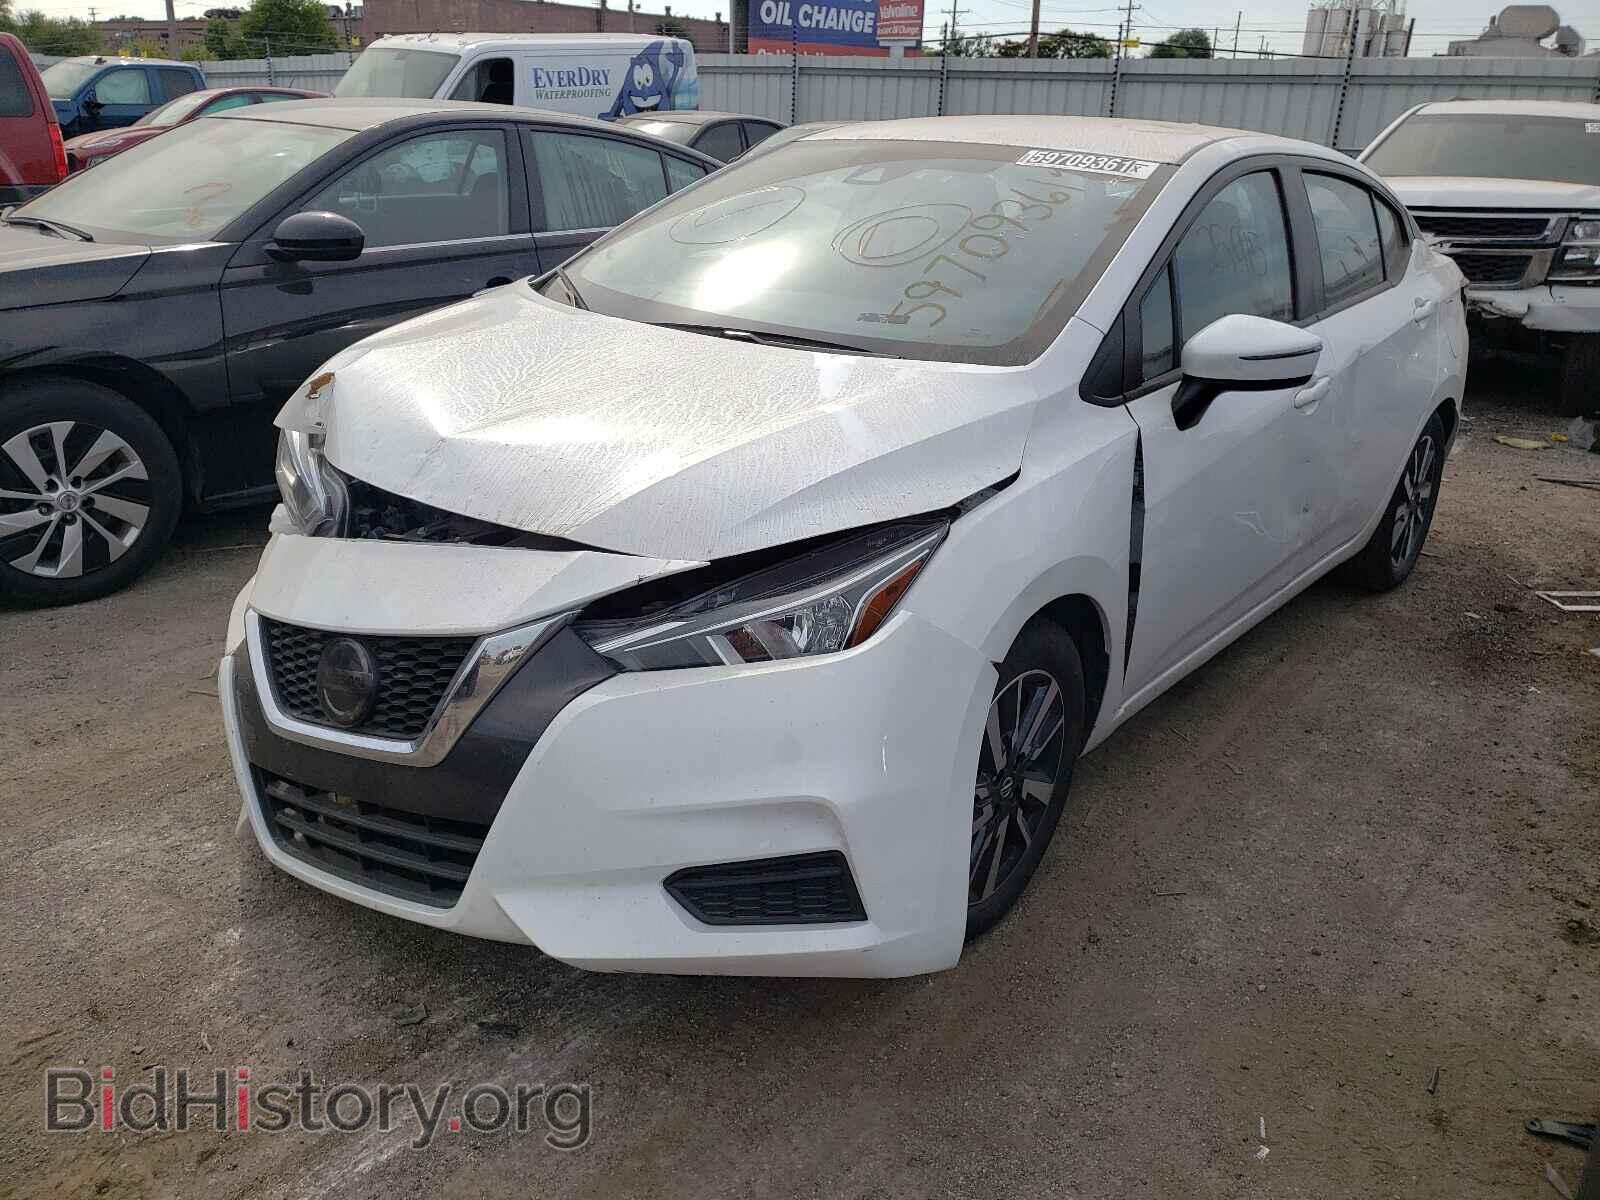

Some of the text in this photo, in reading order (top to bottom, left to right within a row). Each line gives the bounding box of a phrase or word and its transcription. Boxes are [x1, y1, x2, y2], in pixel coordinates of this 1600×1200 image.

[760, 1, 876, 33] OIL CHANGE
[536, 88, 612, 100] WATERPROOFING
[1029, 151, 1134, 174] 59709361
